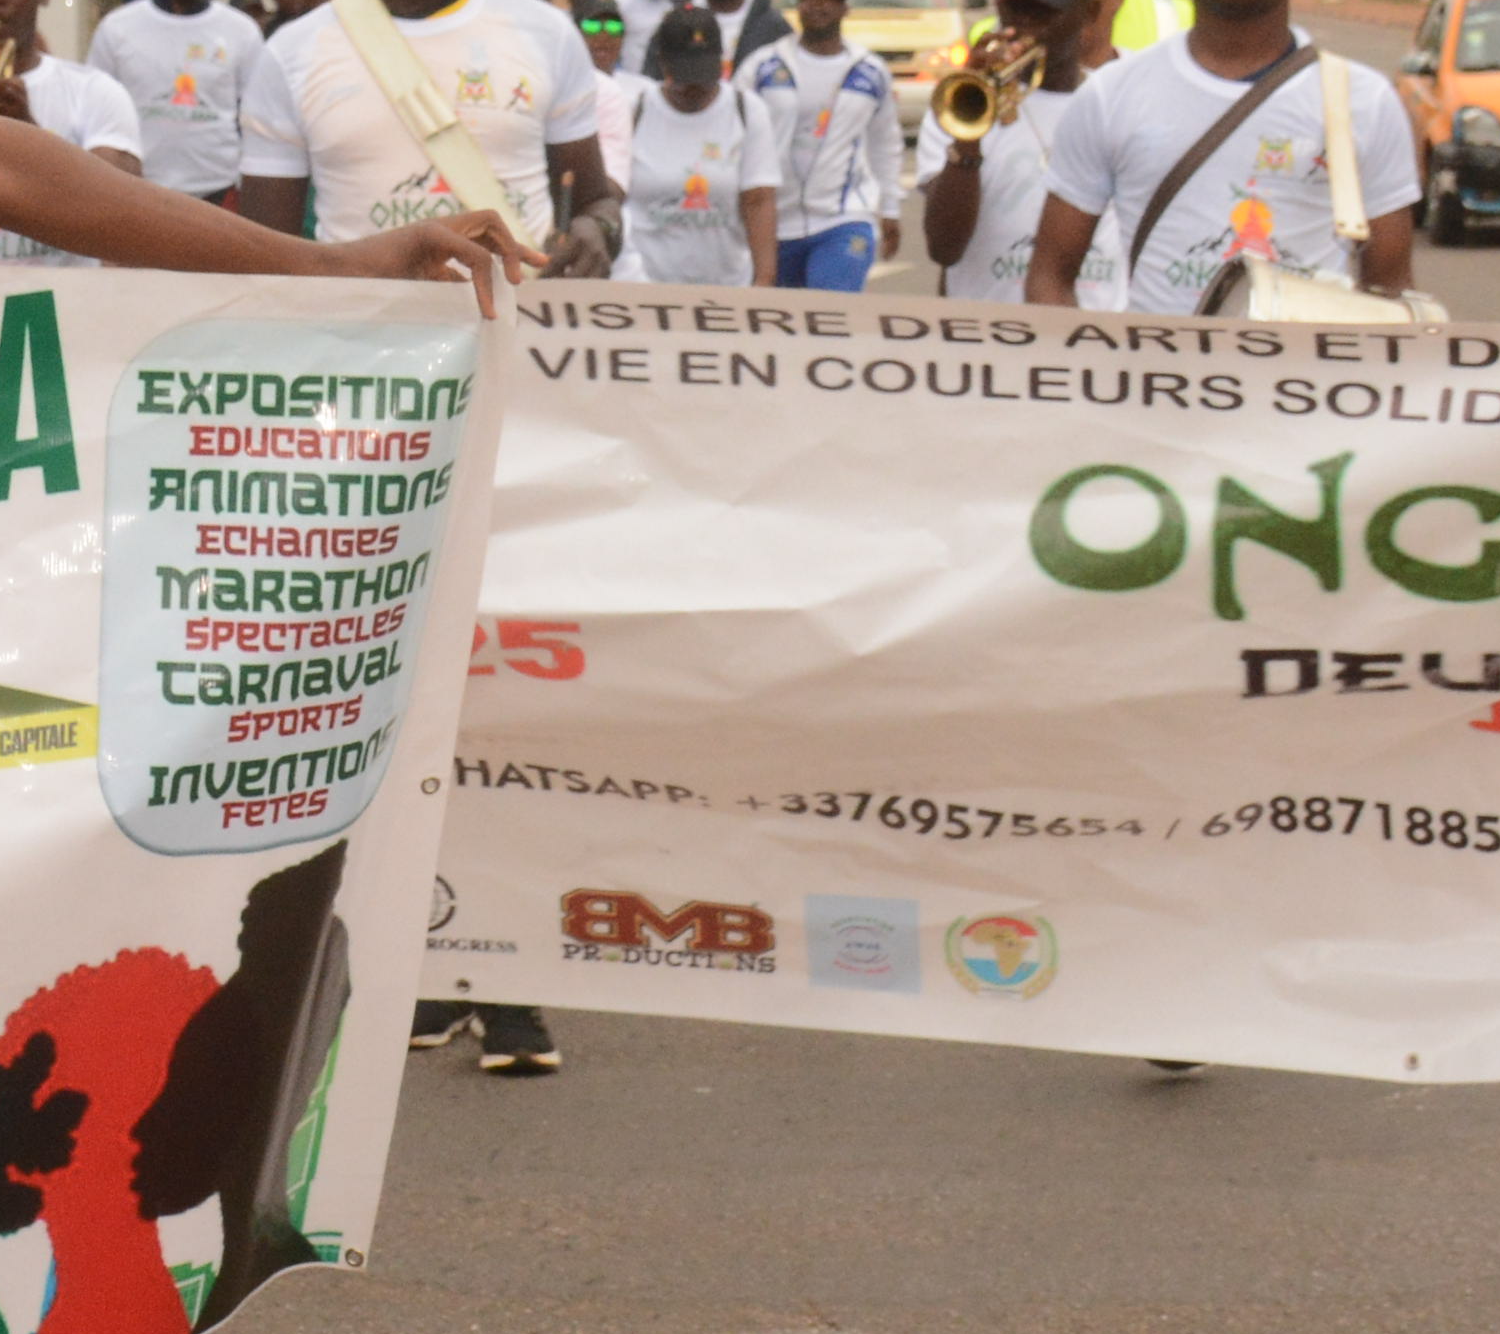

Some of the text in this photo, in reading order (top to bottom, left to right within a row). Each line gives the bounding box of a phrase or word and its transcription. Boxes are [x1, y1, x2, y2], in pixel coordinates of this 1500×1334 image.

[879, 313, 1038, 346] DES
[1064, 323, 1284, 358] ARTS
[1314, 331, 1424, 364] ET
[137, 369, 474, 422] EXPOSITIONS
[529, 346, 652, 383] VIE
[678, 350, 777, 388] EN
[806, 355, 1246, 413] COULEURS
[189, 424, 430, 463] EDUCATIONS
[148, 460, 454, 516] ANIMATIONS
[195, 523, 400, 559] ECHANGES
[156, 548, 430, 614] MARATHON
[186, 603, 406, 652] SPECTACLES
[156, 640, 402, 708] CARNAVAL
[0, 721, 78, 758] CAPITALE
[227, 697, 362, 743] SPORTS
[148, 720, 397, 808] INVENTIONS
[221, 788, 328, 830] FETES
